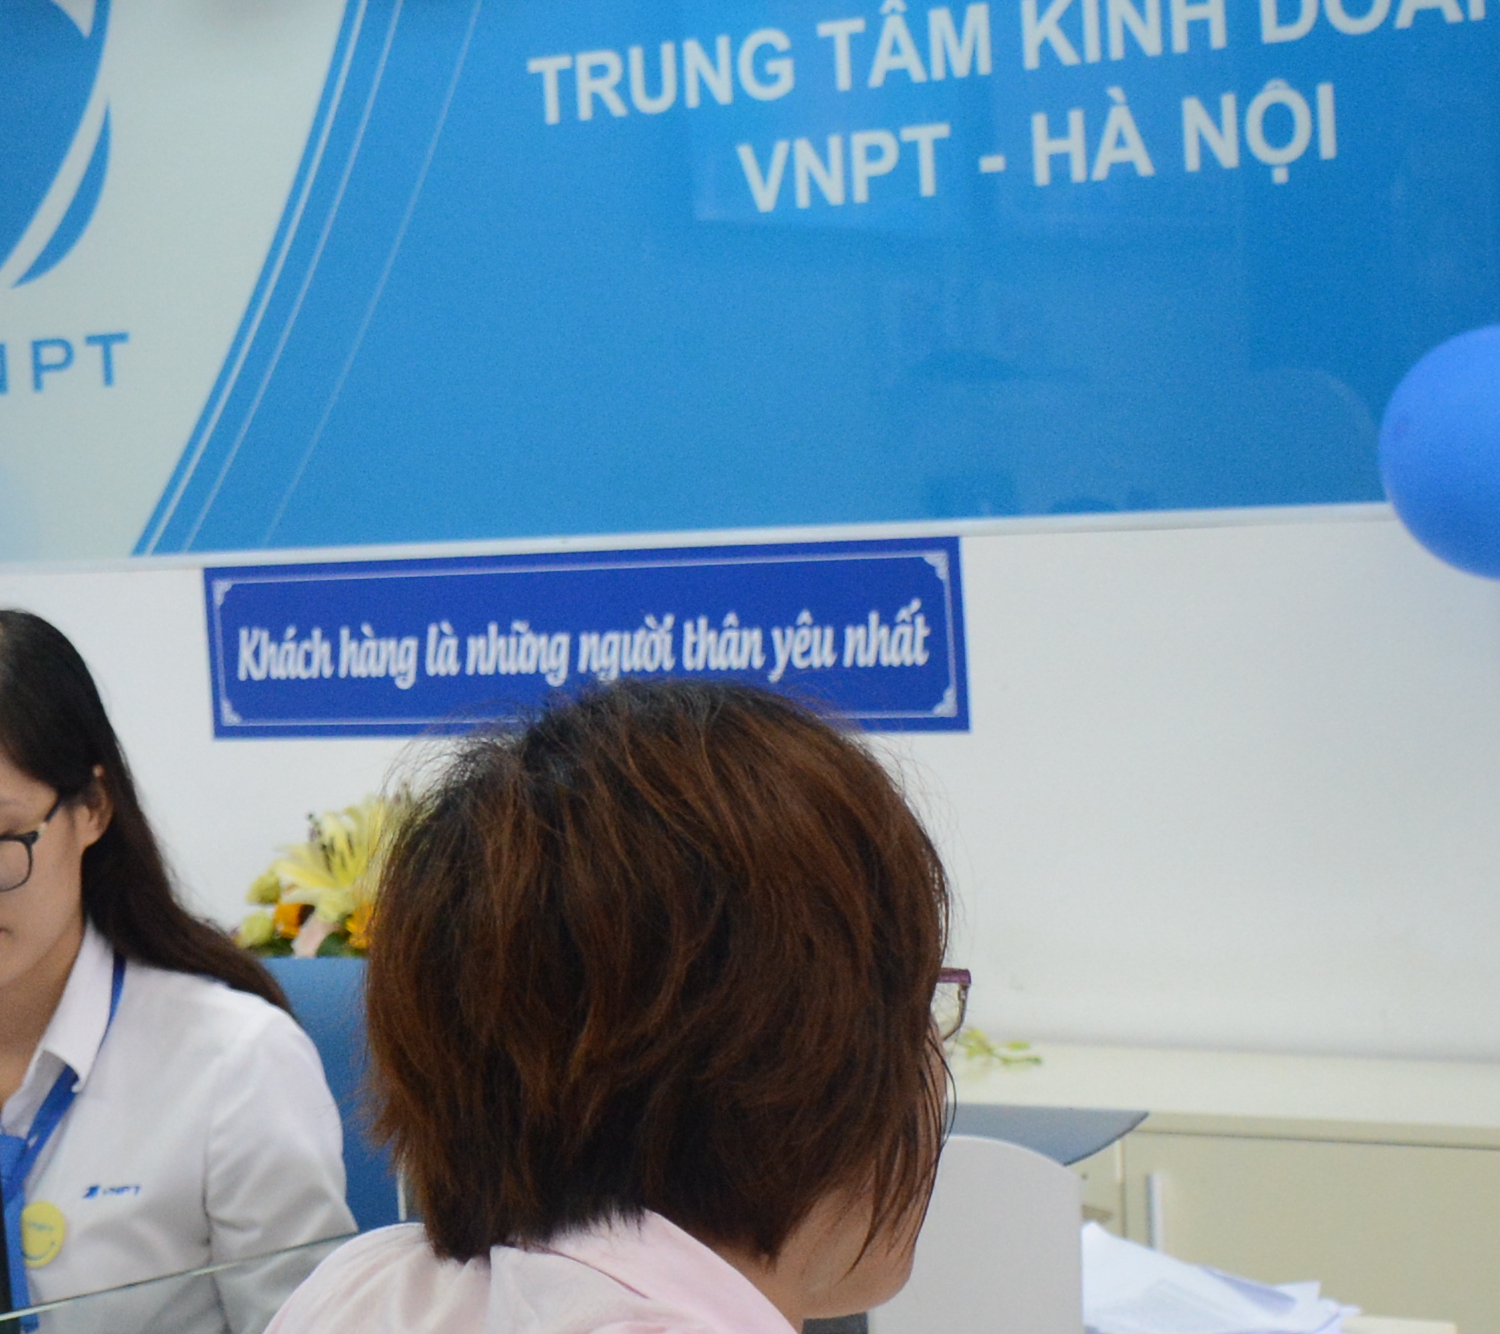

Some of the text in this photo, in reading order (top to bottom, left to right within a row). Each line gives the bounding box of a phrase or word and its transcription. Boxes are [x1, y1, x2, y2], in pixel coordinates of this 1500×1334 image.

[526, 26, 798, 126] TRUNG
[736, 78, 1338, 214] VNPT - HÀ NỘI
[236, 597, 931, 691] Khách hàng là những người thân yêu nhất
